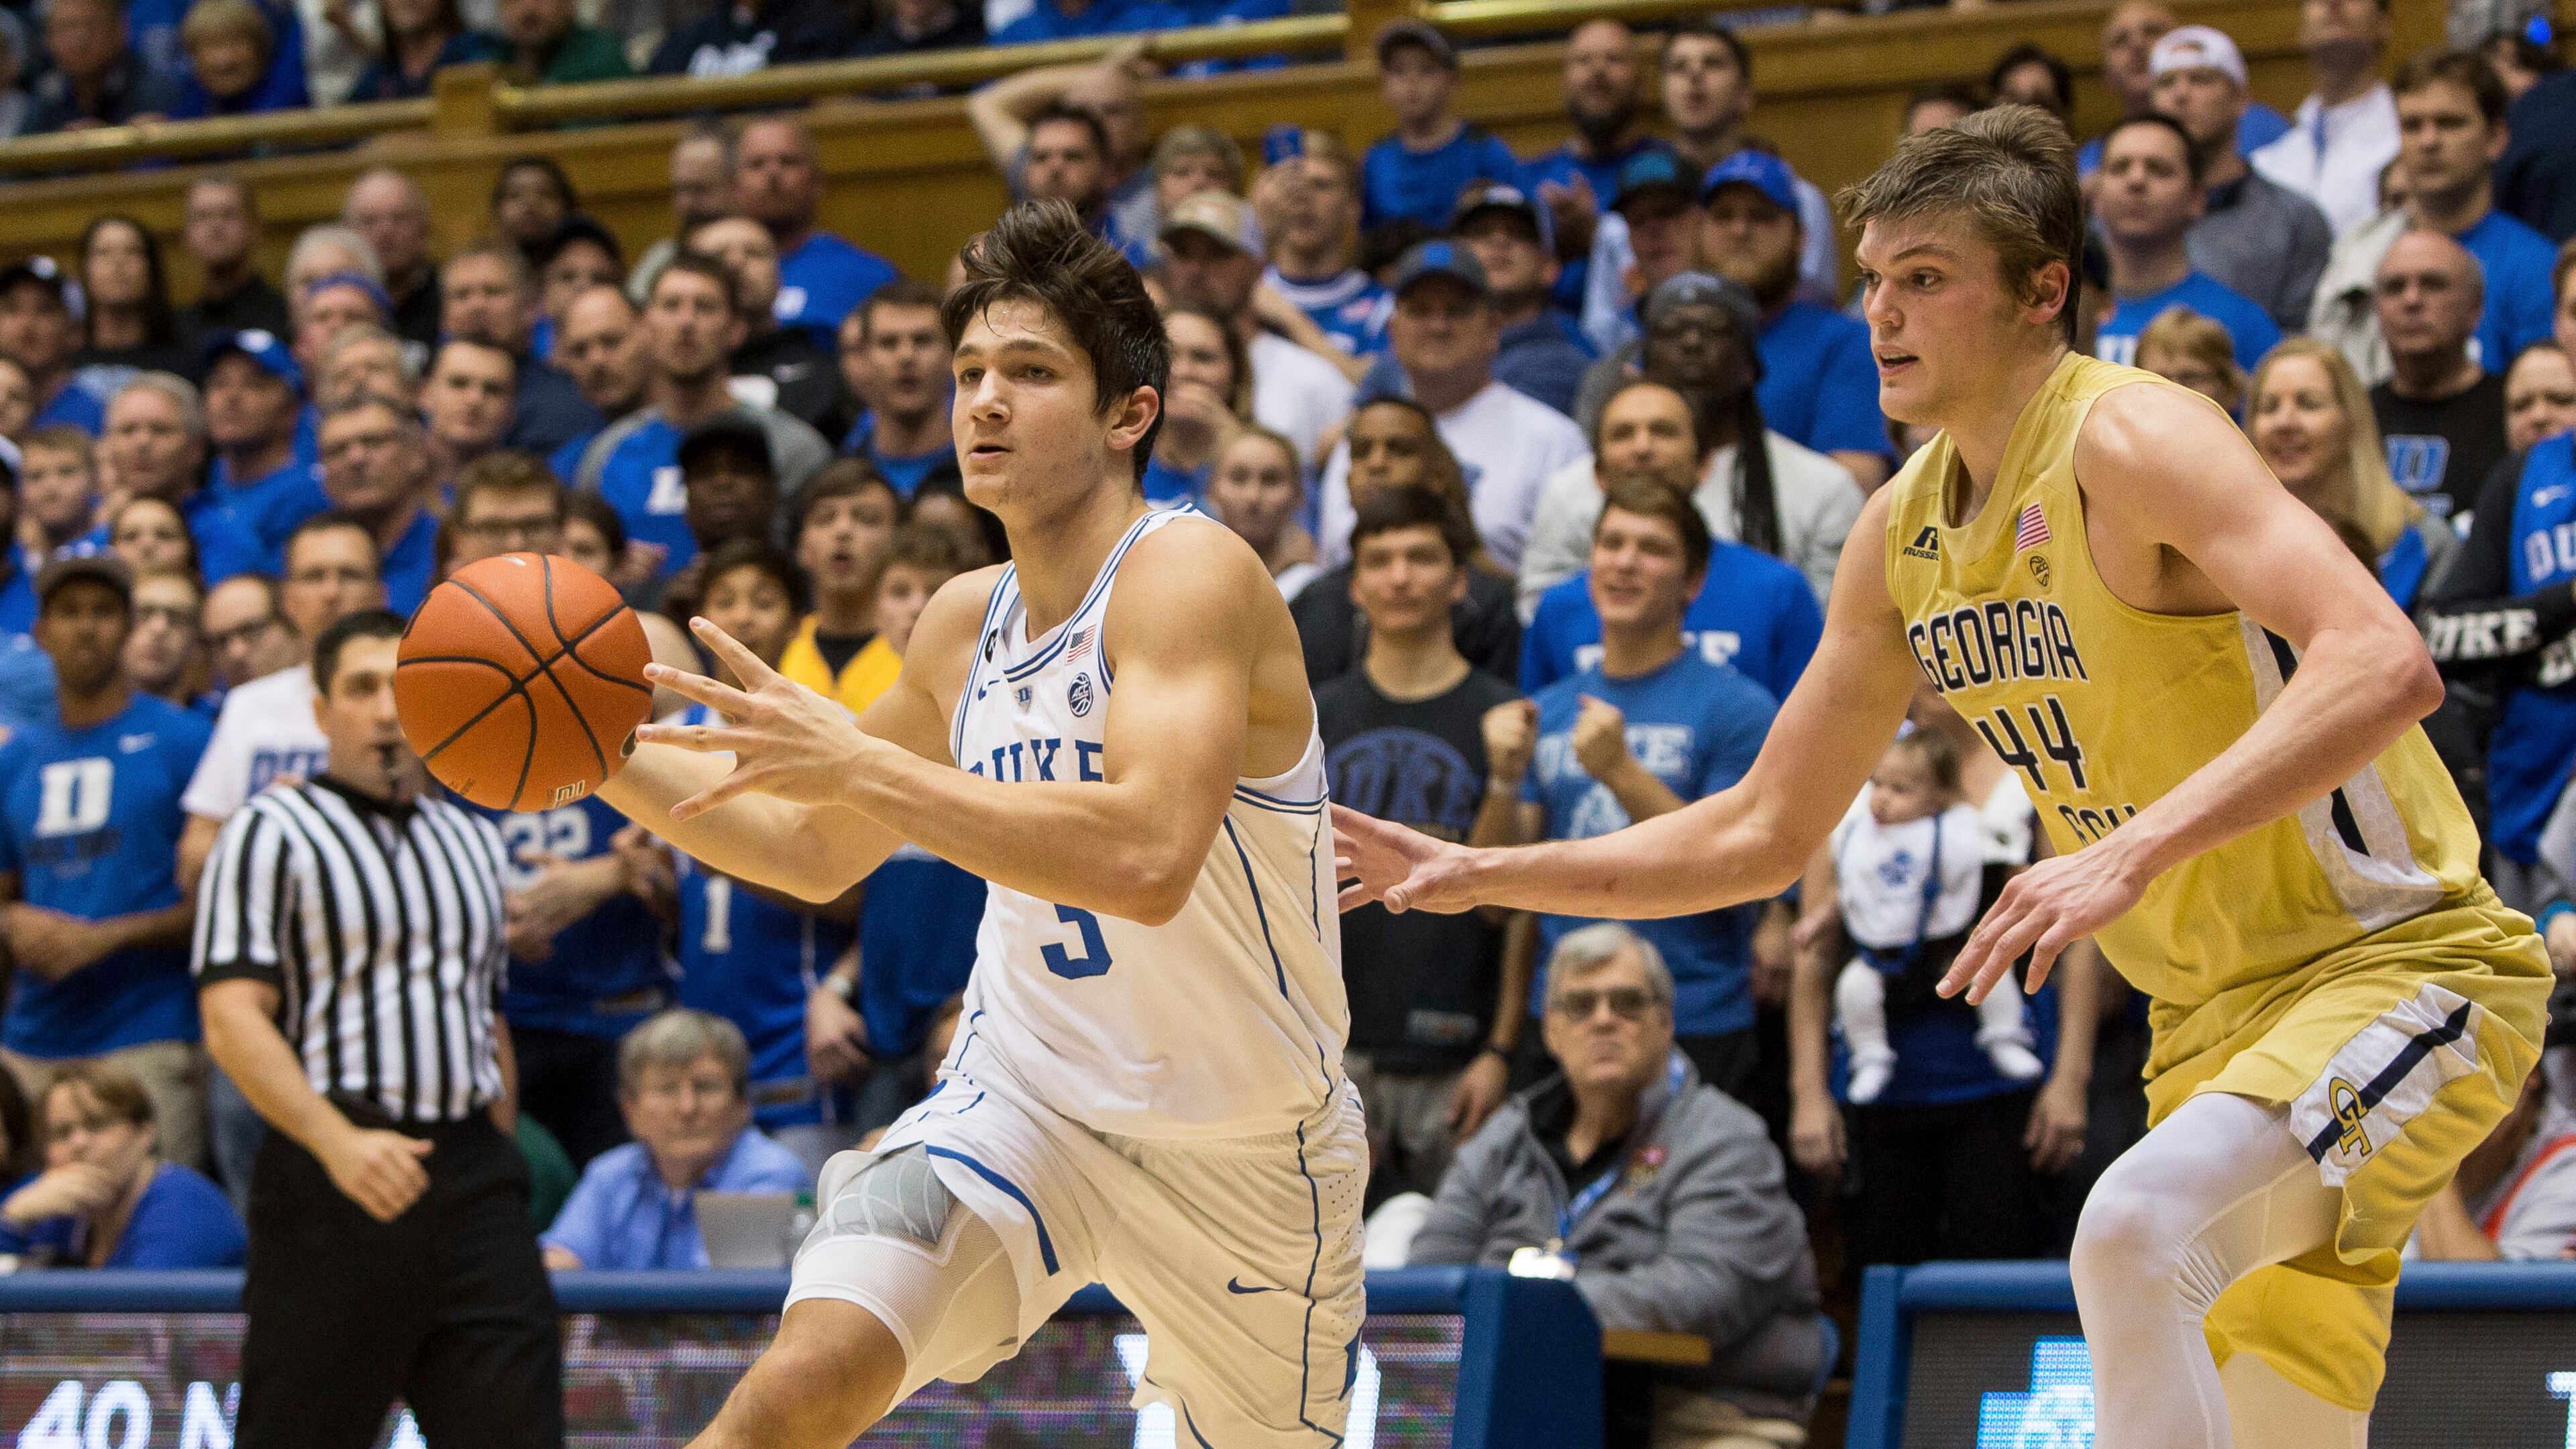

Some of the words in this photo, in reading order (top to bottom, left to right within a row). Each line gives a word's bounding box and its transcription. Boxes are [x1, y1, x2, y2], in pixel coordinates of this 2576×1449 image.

[1908, 599, 2089, 694] GEORGIA
[1071, 683, 1090, 700] ACC
[969, 738, 1104, 782] UKE
[1974, 695, 2088, 793] 44
[36, 756, 115, 837] D
[701, 875, 732, 953] 1
